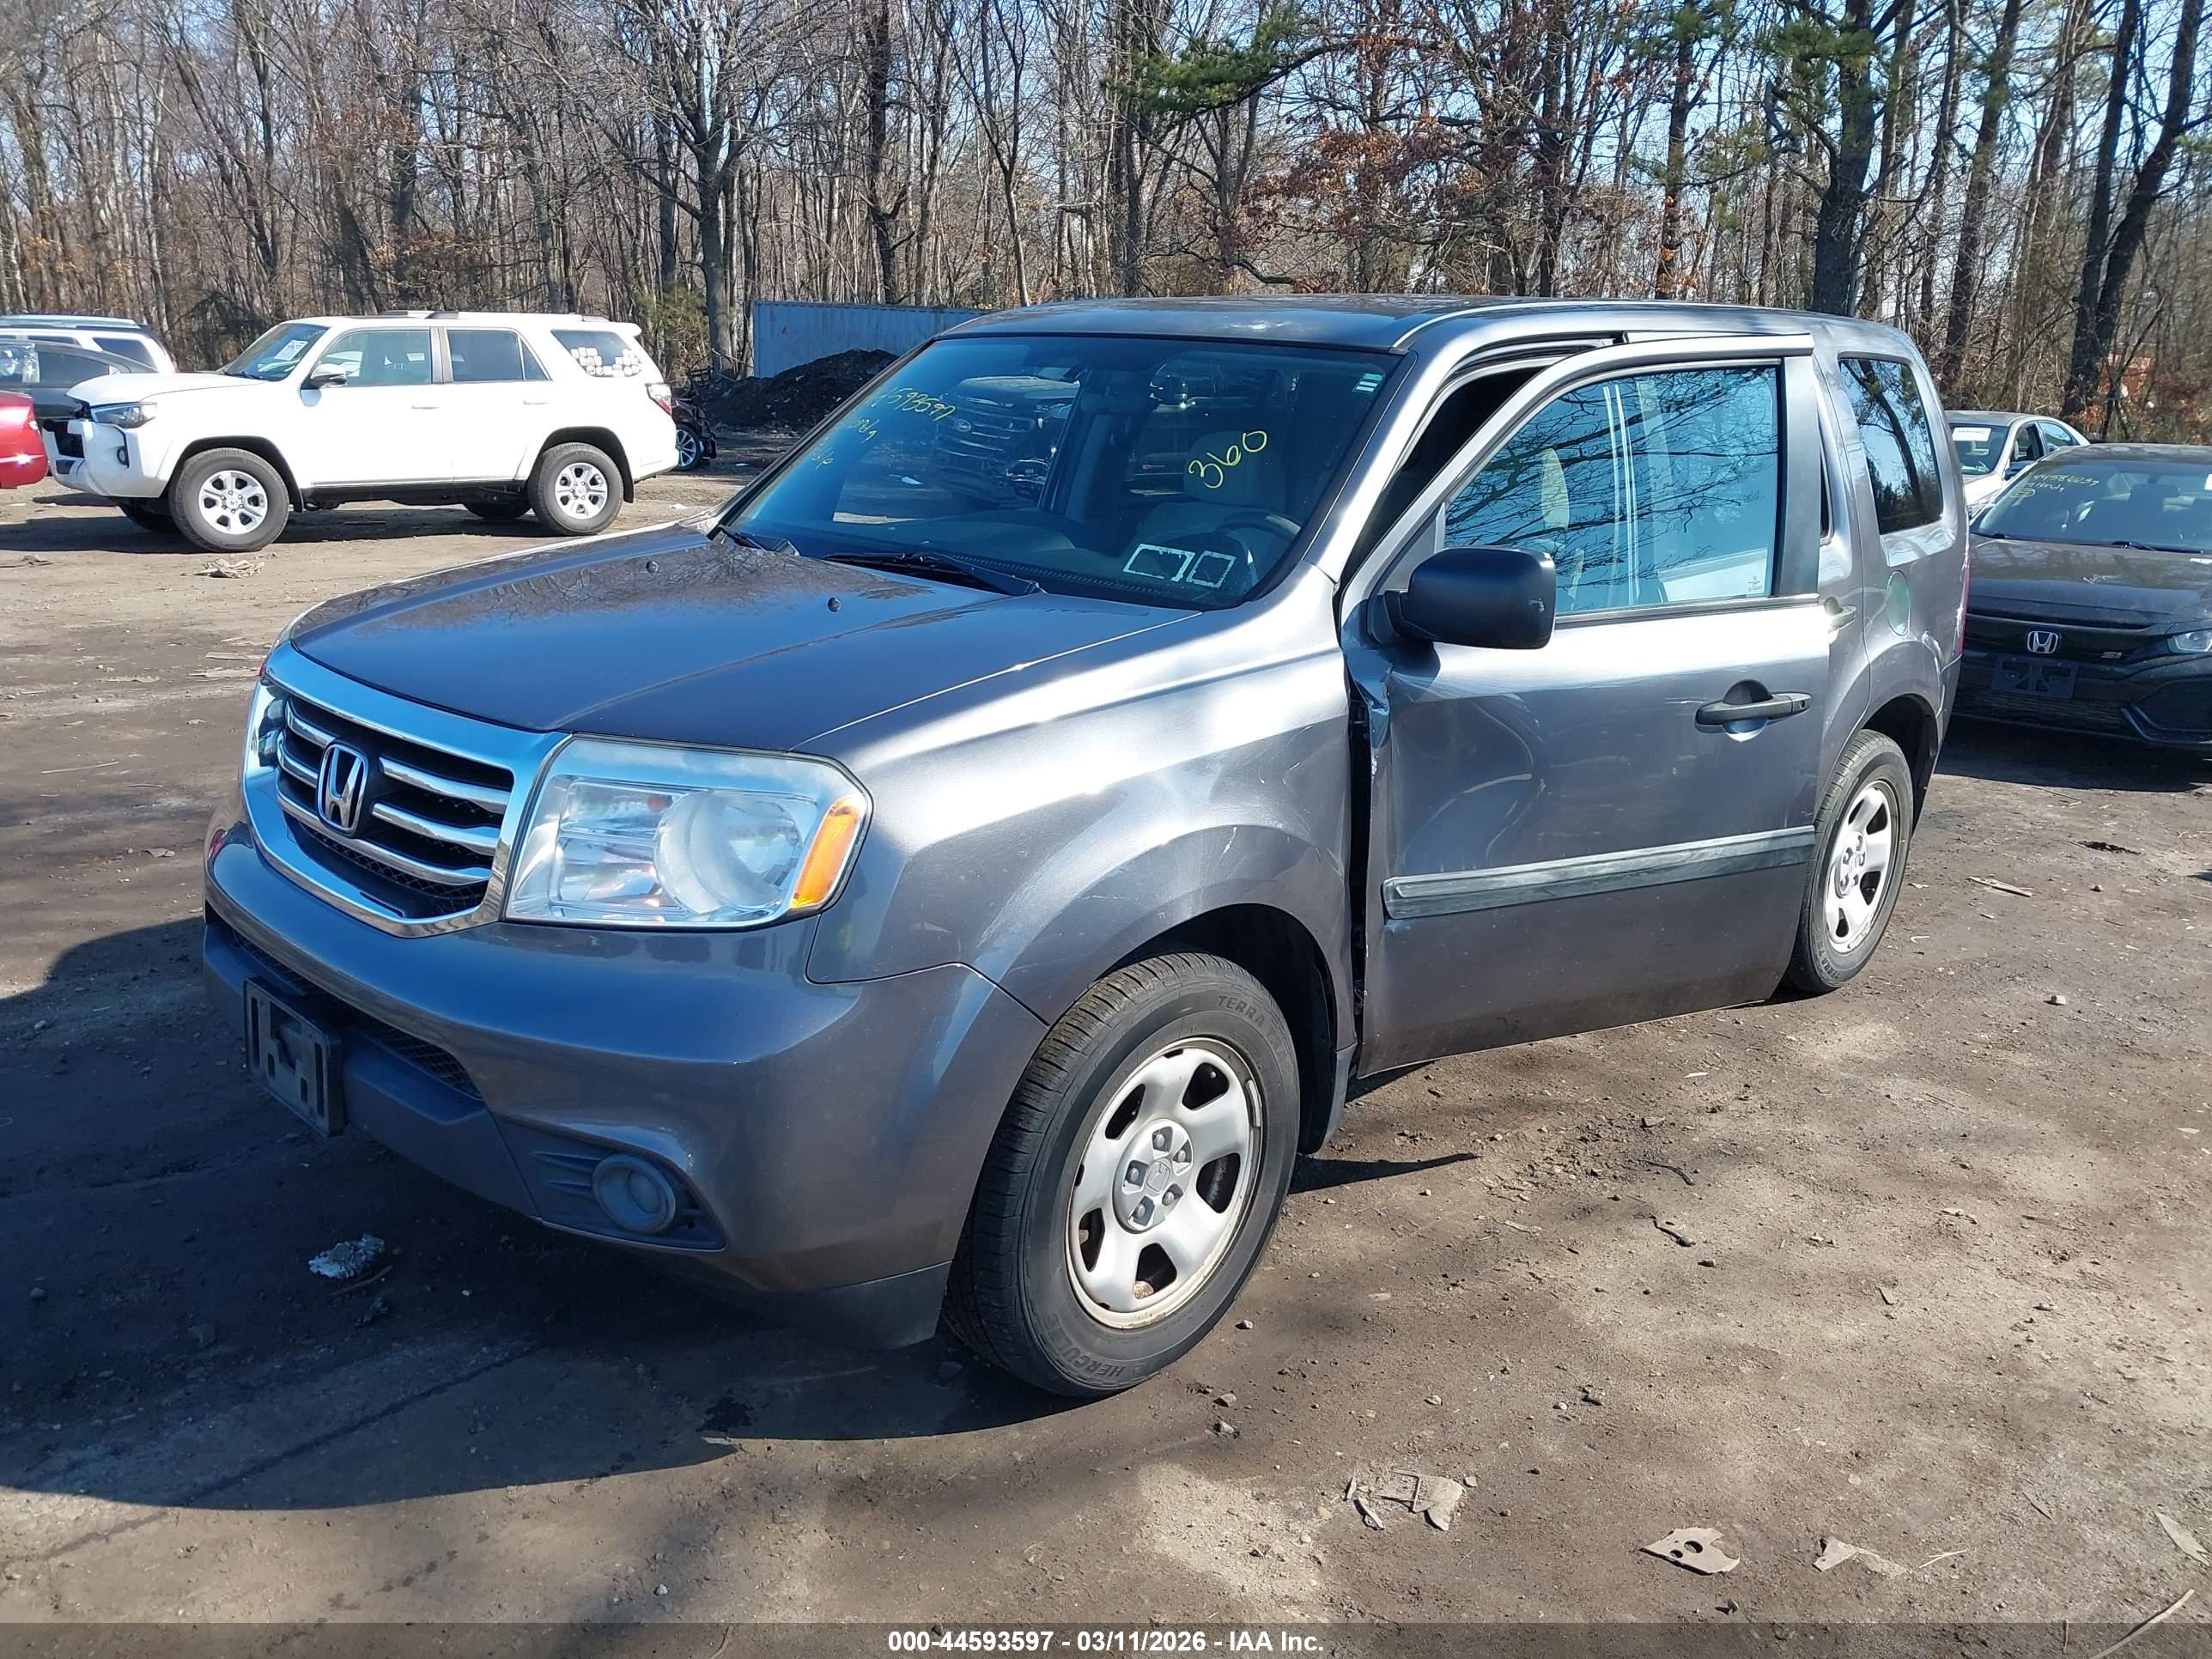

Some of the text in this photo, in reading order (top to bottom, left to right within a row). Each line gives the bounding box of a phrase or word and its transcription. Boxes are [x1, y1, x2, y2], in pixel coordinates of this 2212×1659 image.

[1188, 430, 1267, 489] 360
[1217, 994, 1267, 1027] TERRA
[1043, 1312, 1127, 1378] HERCULES
